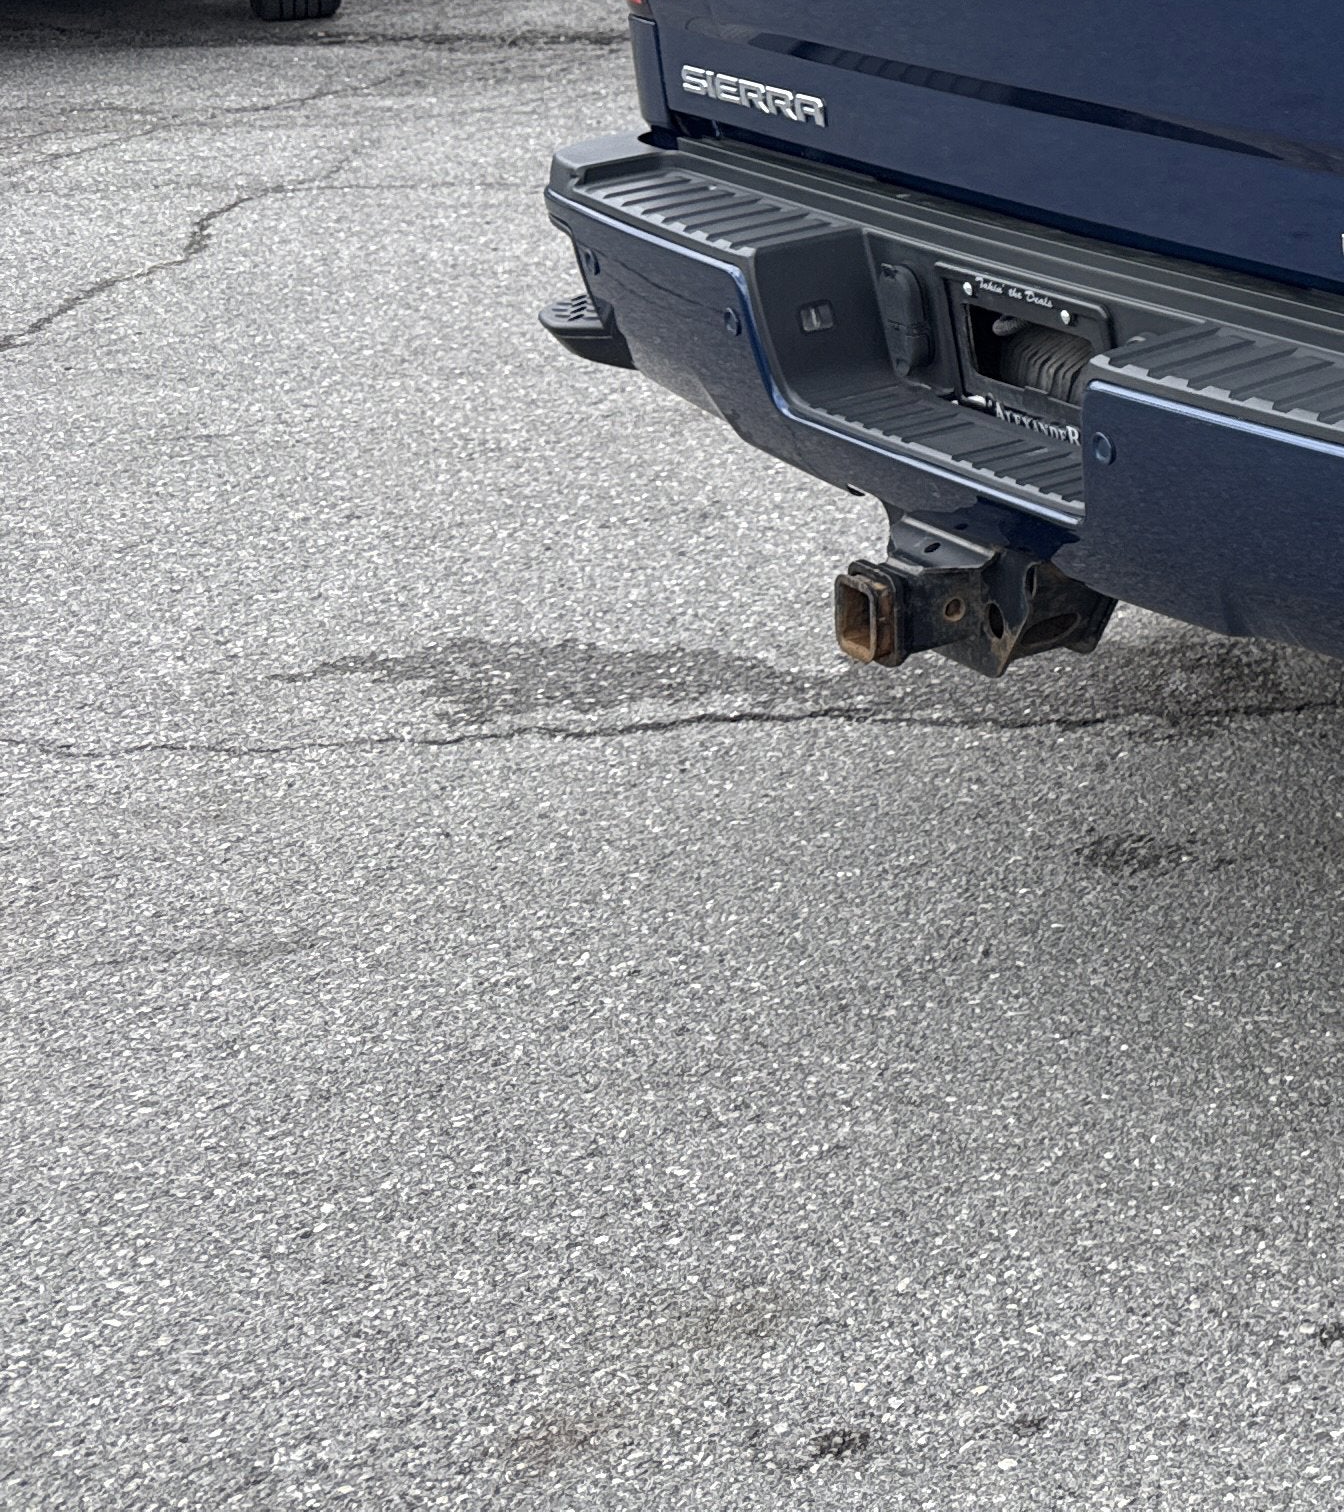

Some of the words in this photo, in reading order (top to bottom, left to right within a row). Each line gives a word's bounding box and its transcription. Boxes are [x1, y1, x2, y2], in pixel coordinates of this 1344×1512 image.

[681, 64, 828, 128] SIERRA
[1008, 288, 1023, 300] the
[1024, 290, 1053, 308] Deals
